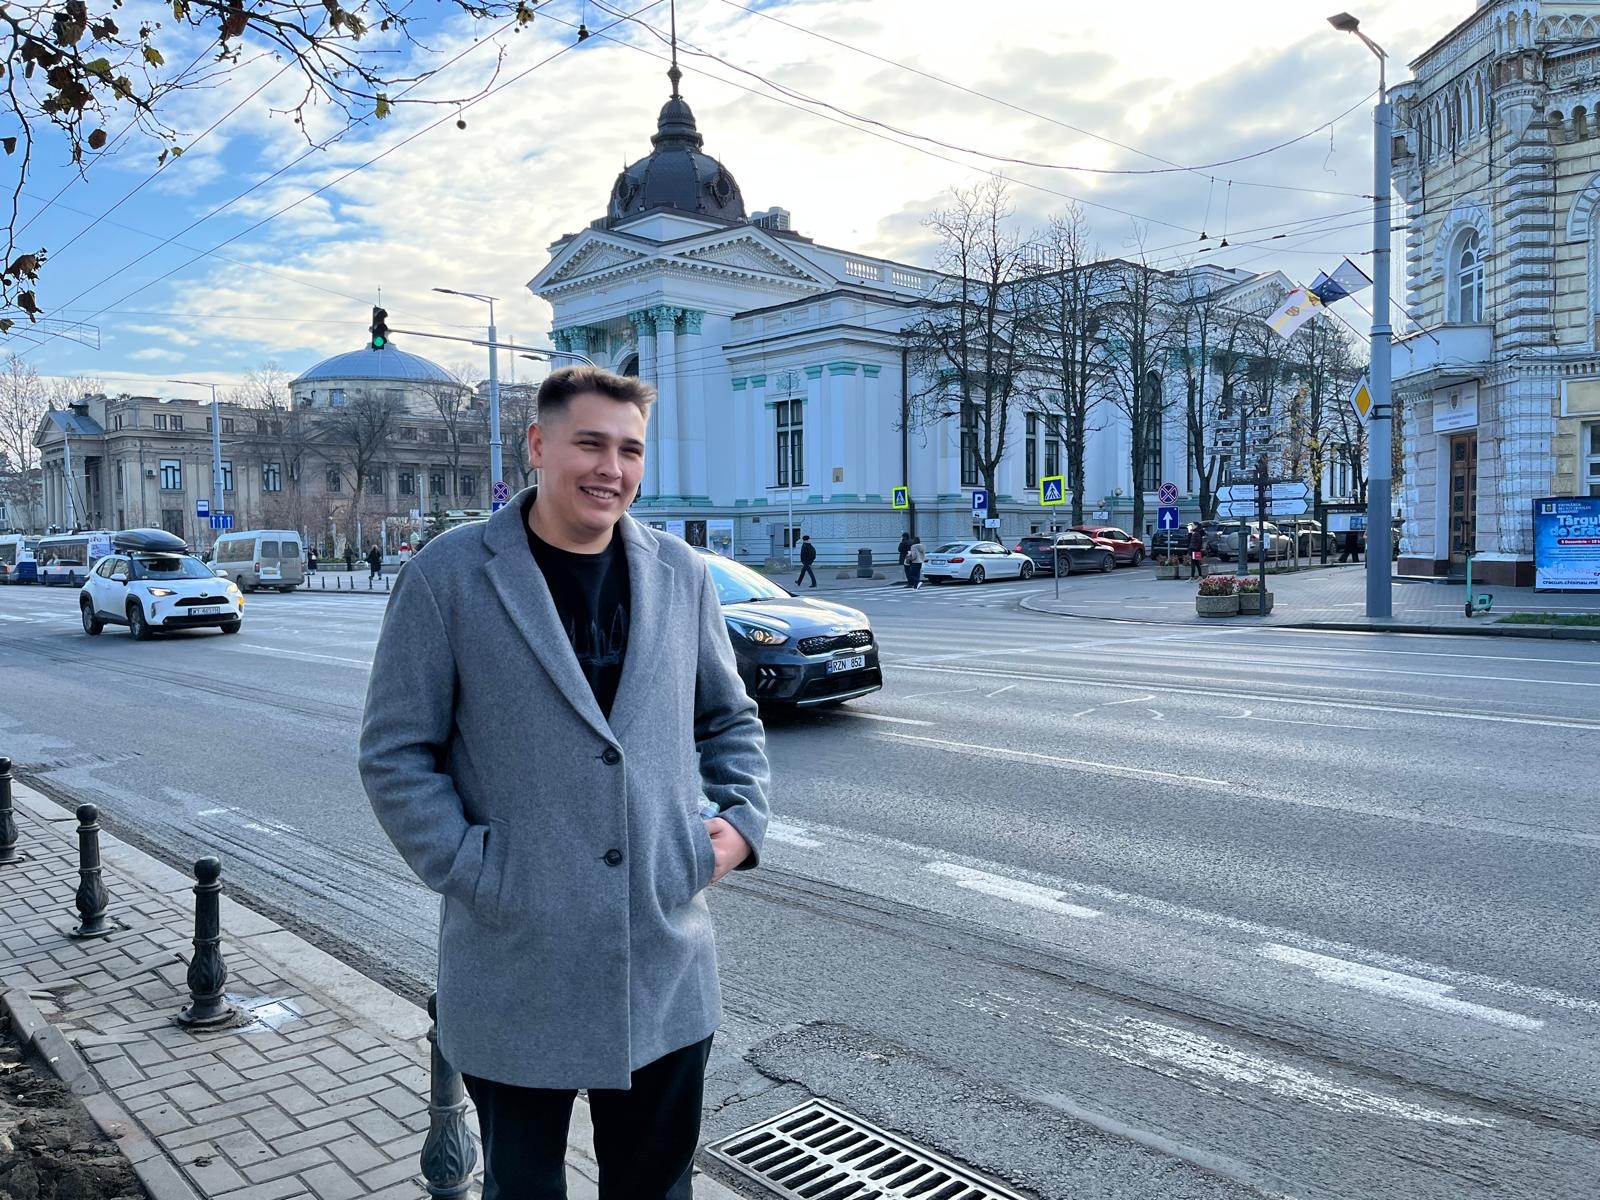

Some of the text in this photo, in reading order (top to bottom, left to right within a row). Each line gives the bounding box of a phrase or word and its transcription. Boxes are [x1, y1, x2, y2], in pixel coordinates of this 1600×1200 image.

[974, 493, 984, 508] P
[1551, 526, 1567, 536] de
[833, 657, 862, 671] RZN 852
